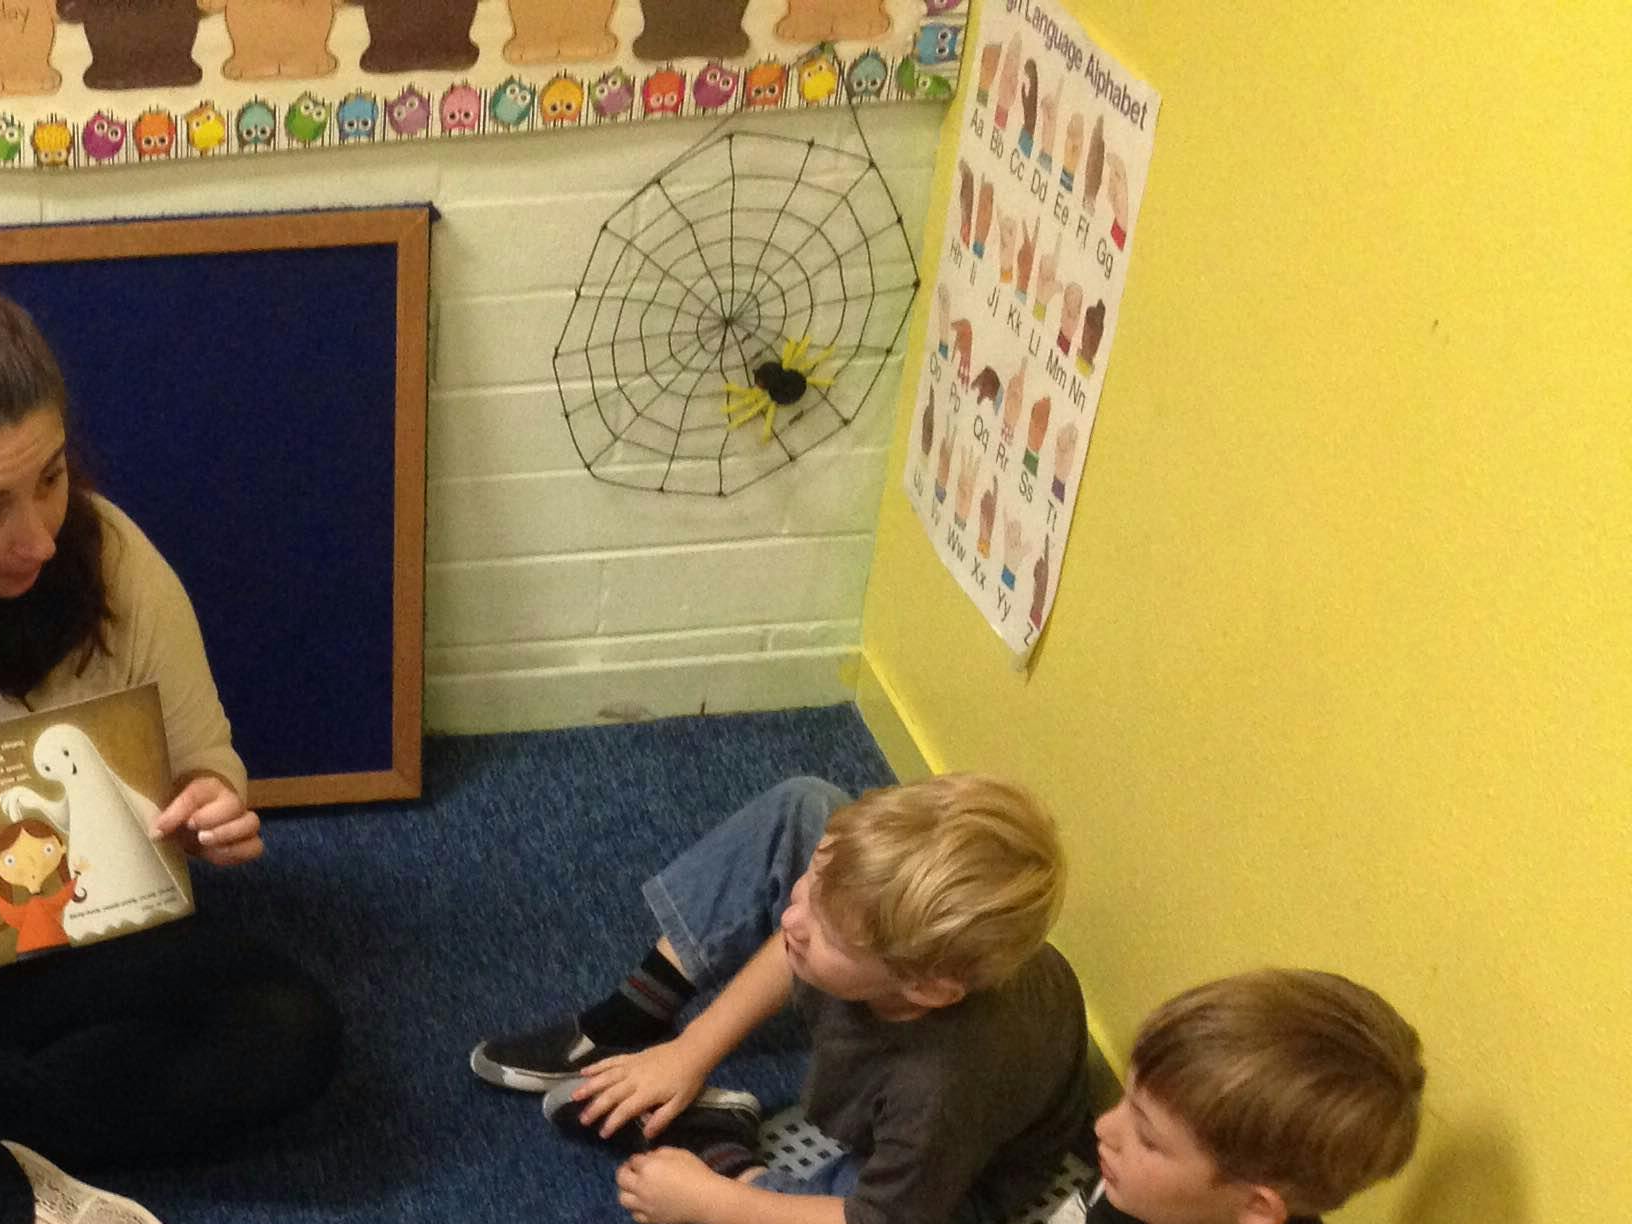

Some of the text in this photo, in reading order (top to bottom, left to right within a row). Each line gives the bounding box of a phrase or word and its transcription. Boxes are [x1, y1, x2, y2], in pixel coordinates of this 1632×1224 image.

[1024, 0, 1083, 71] Language
[1084, 53, 1148, 131] Alphabet
[970, 108, 984, 139] Aa
[990, 127, 1004, 159] Bb
[1009, 148, 1025, 181] Cc
[1030, 169, 1048, 203] Dd
[1053, 191, 1069, 226] Ee
[1096, 237, 1114, 280] Gg
[1006, 304, 1023, 337] Kk
[1045, 348, 1067, 390] Mm
[1068, 375, 1087, 414] Nn
[973, 415, 990, 454] Qq
[995, 442, 1009, 472] Rr
[1018, 471, 1034, 504] Ss
[1046, 498, 1058, 533] Tt
[971, 556, 987, 591] Xx
[997, 586, 1012, 623] Yy
